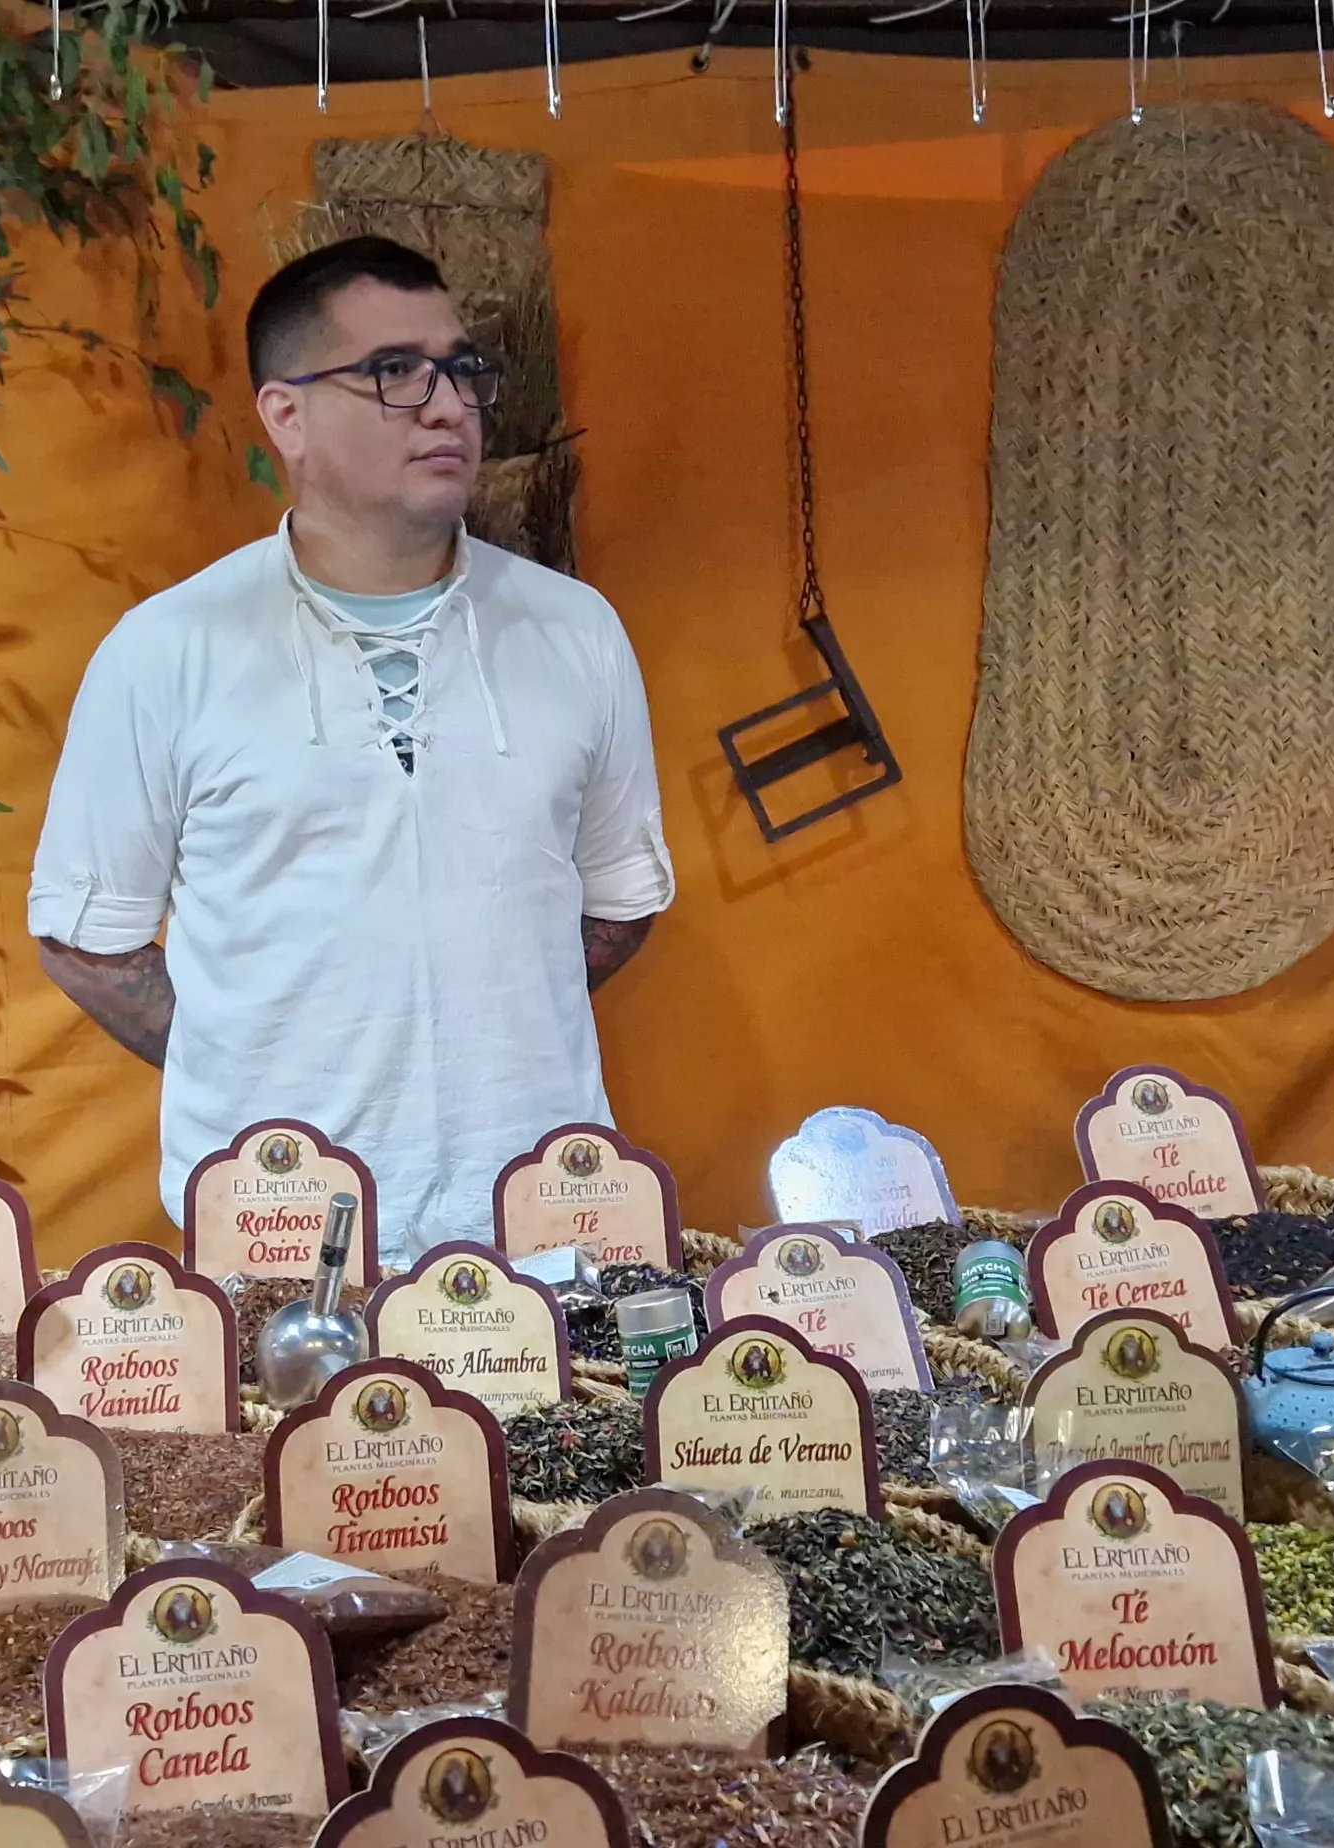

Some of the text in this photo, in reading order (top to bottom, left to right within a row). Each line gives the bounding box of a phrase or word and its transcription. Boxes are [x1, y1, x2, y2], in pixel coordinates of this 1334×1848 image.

[1119, 1115, 1200, 1137] EL ERMITAÑO
[1153, 1143, 1180, 1169] Té
[234, 1176, 327, 1195] EL ERMITAÑO
[539, 1179, 629, 1197] EL ERMITAÑO
[236, 1206, 323, 1237] Roiboos
[573, 1210, 598, 1233] Té
[248, 1238, 311, 1263] Osiris
[1077, 1242, 1170, 1270] EL ERMITAÑO
[962, 1263, 1012, 1280] MATCHA
[782, 1276, 856, 1298] ERMITAÑO
[1082, 1278, 1187, 1311] Té Cereza
[76, 1313, 184, 1337] EL ERMITAÑO
[417, 1306, 515, 1325] EL ERMITAÑO
[798, 1308, 827, 1333] Té
[81, 1350, 180, 1387] Roiboos
[458, 1348, 548, 1377] Alhambra
[79, 1383, 181, 1419] Vainilla
[703, 1392, 813, 1414] EL ERMITAÑO
[1077, 1382, 1192, 1406] EL ERMITAÑO
[710, 1411, 808, 1422] PLANTAS MEDICINALES
[326, 1434, 443, 1462] EL ERMITAÑO
[670, 1433, 852, 1470] Silueta de Verano
[1169, 1432, 1230, 1468] Cúrcuma
[332, 1456, 437, 1473] PLANTAS MEDICINALES
[332, 1475, 440, 1518] Roiboos
[328, 1514, 448, 1555] Tiramisú
[1063, 1543, 1190, 1570] EL ERMITAÑO
[589, 1583, 615, 1608] EL
[1112, 1588, 1149, 1625] Té
[118, 1645, 258, 1678] EL ERMITAÑO
[1058, 1632, 1218, 1673] Melocotón
[127, 1670, 251, 1690] PLANTAS MEDICINALES
[125, 1691, 255, 1741] Roiboos
[140, 1734, 251, 1787] Canela
[942, 1815, 972, 1845] EL
[976, 1787, 1088, 1832] ERMITAÑO
